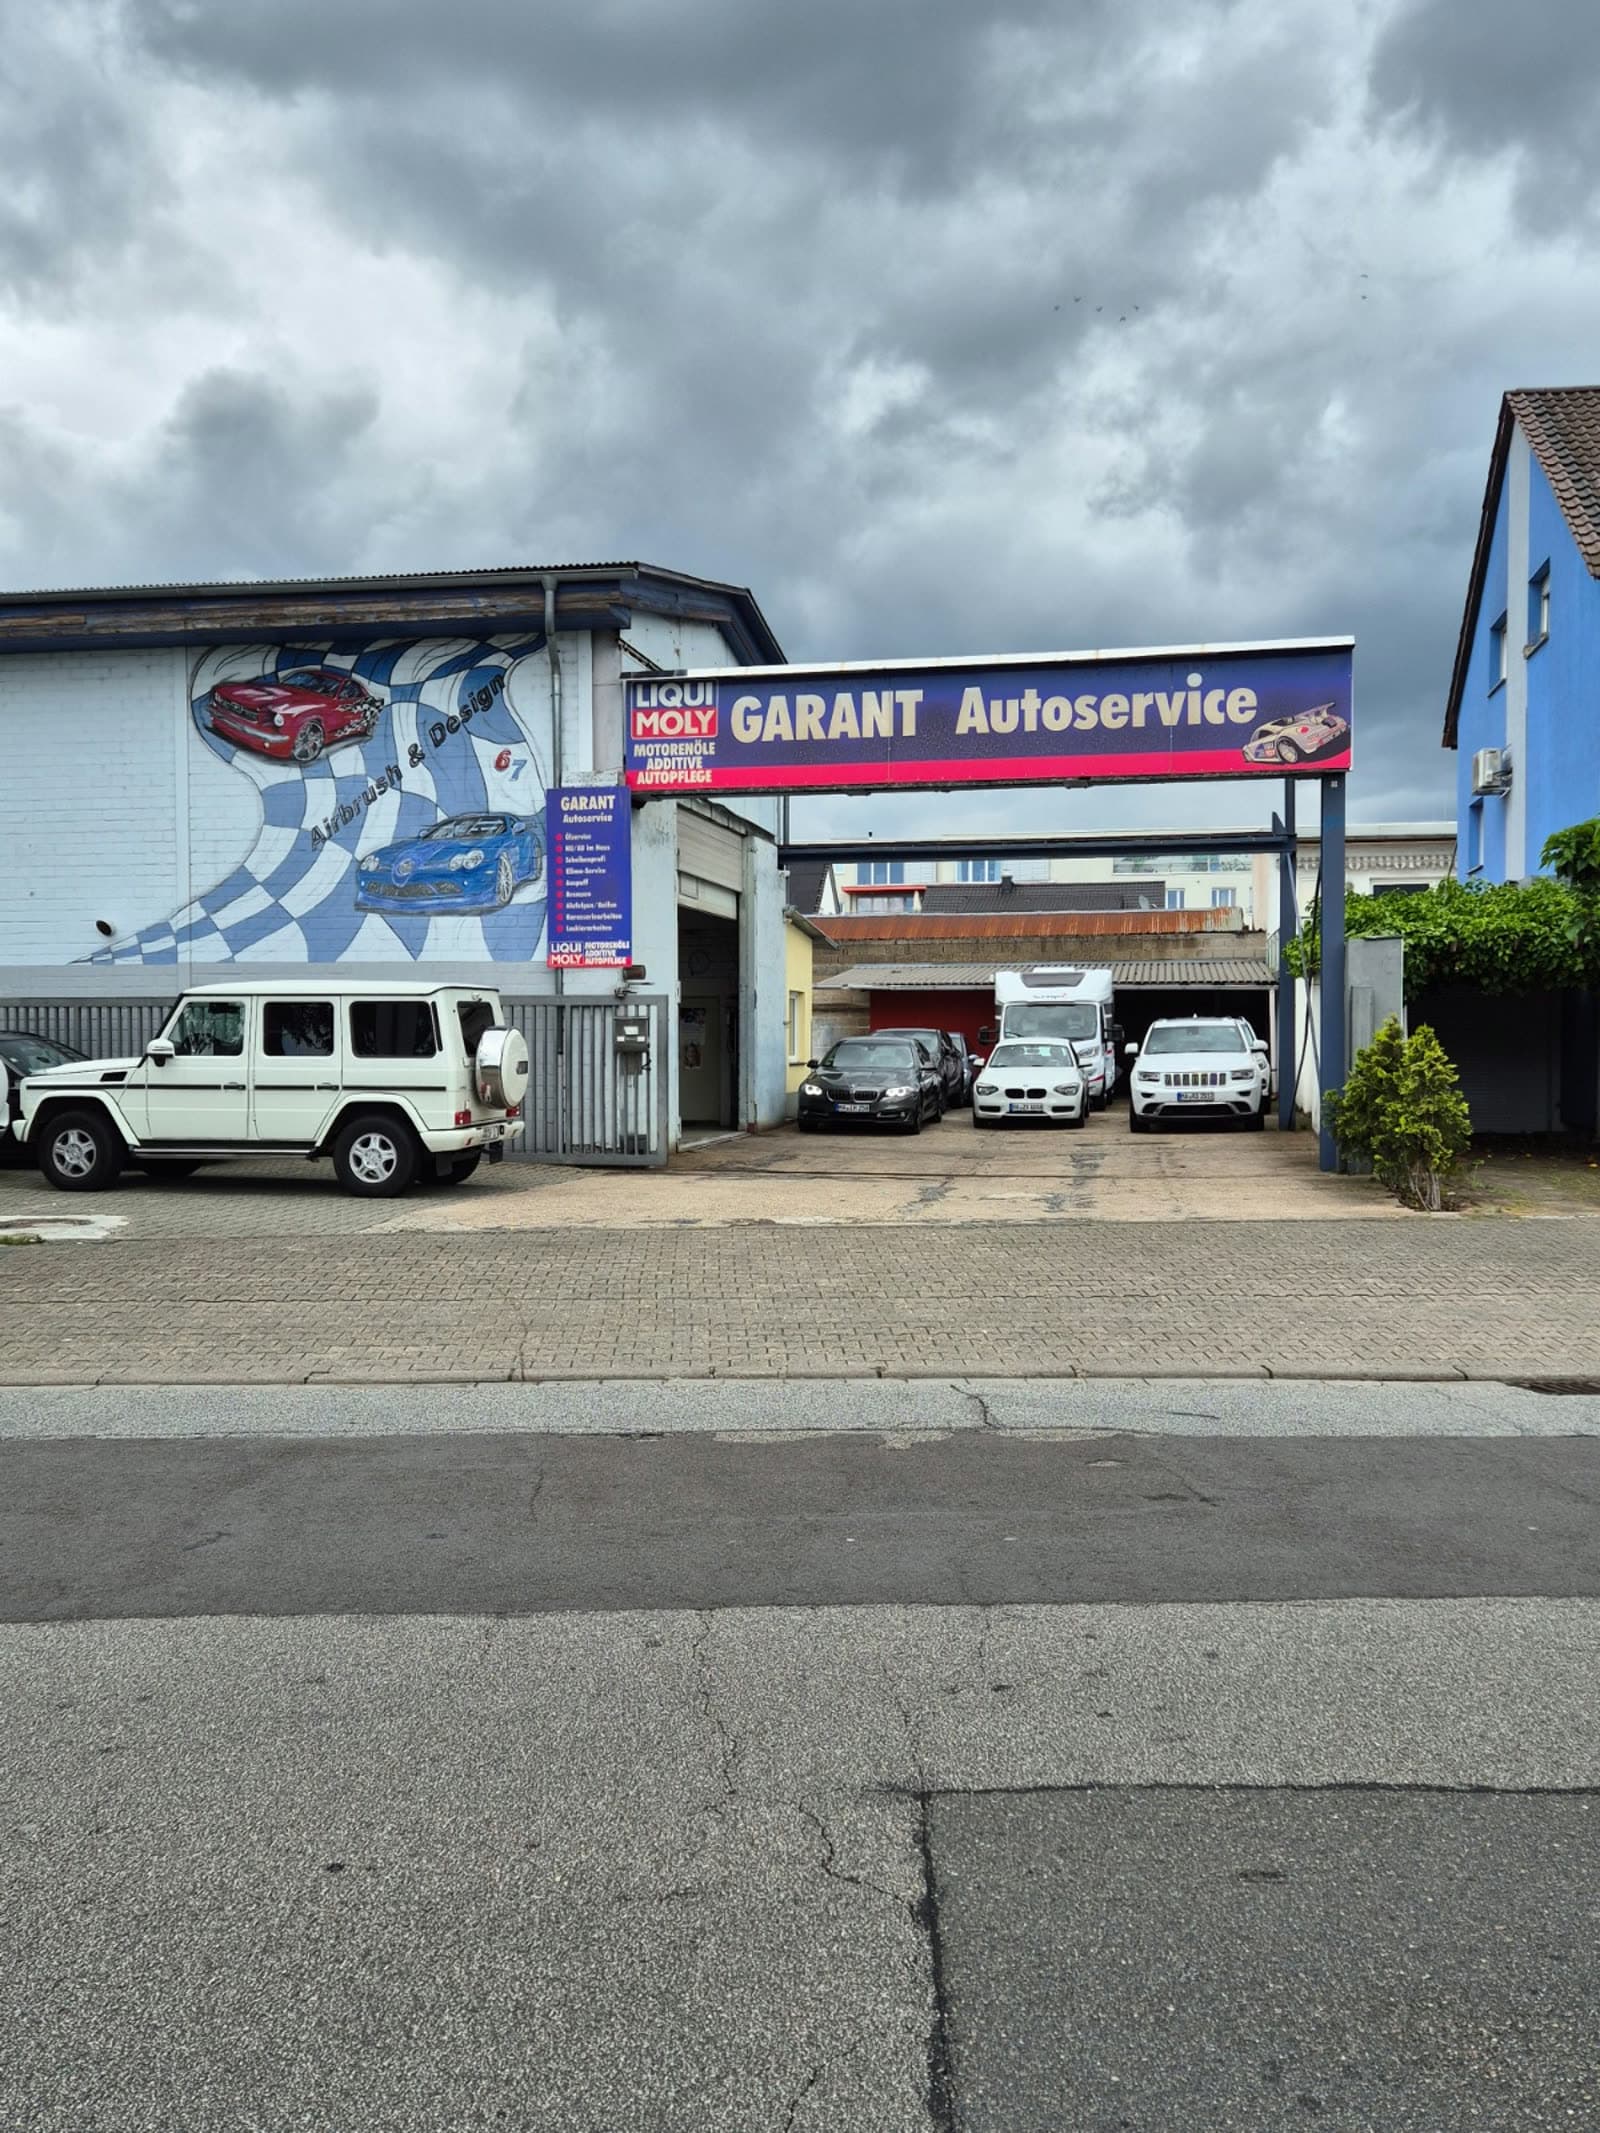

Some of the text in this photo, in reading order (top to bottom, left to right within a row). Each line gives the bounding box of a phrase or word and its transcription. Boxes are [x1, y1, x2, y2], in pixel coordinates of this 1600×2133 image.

[636, 682, 713, 708] LIQUI
[730, 672, 1258, 744] GARANT Autoservice
[636, 710, 715, 736] MOLY
[633, 739, 716, 757] MOTORENÖLE
[311, 674, 506, 852] Airbrush & Design
[646, 756, 703, 770] ADDITIVE
[637, 769, 713, 785] AUTOPFLEGE
[560, 795, 616, 811] GARANT
[563, 812, 613, 823] Autoservice
[551, 943, 582, 953] LIQUI
[551, 954, 582, 965] MOLY
